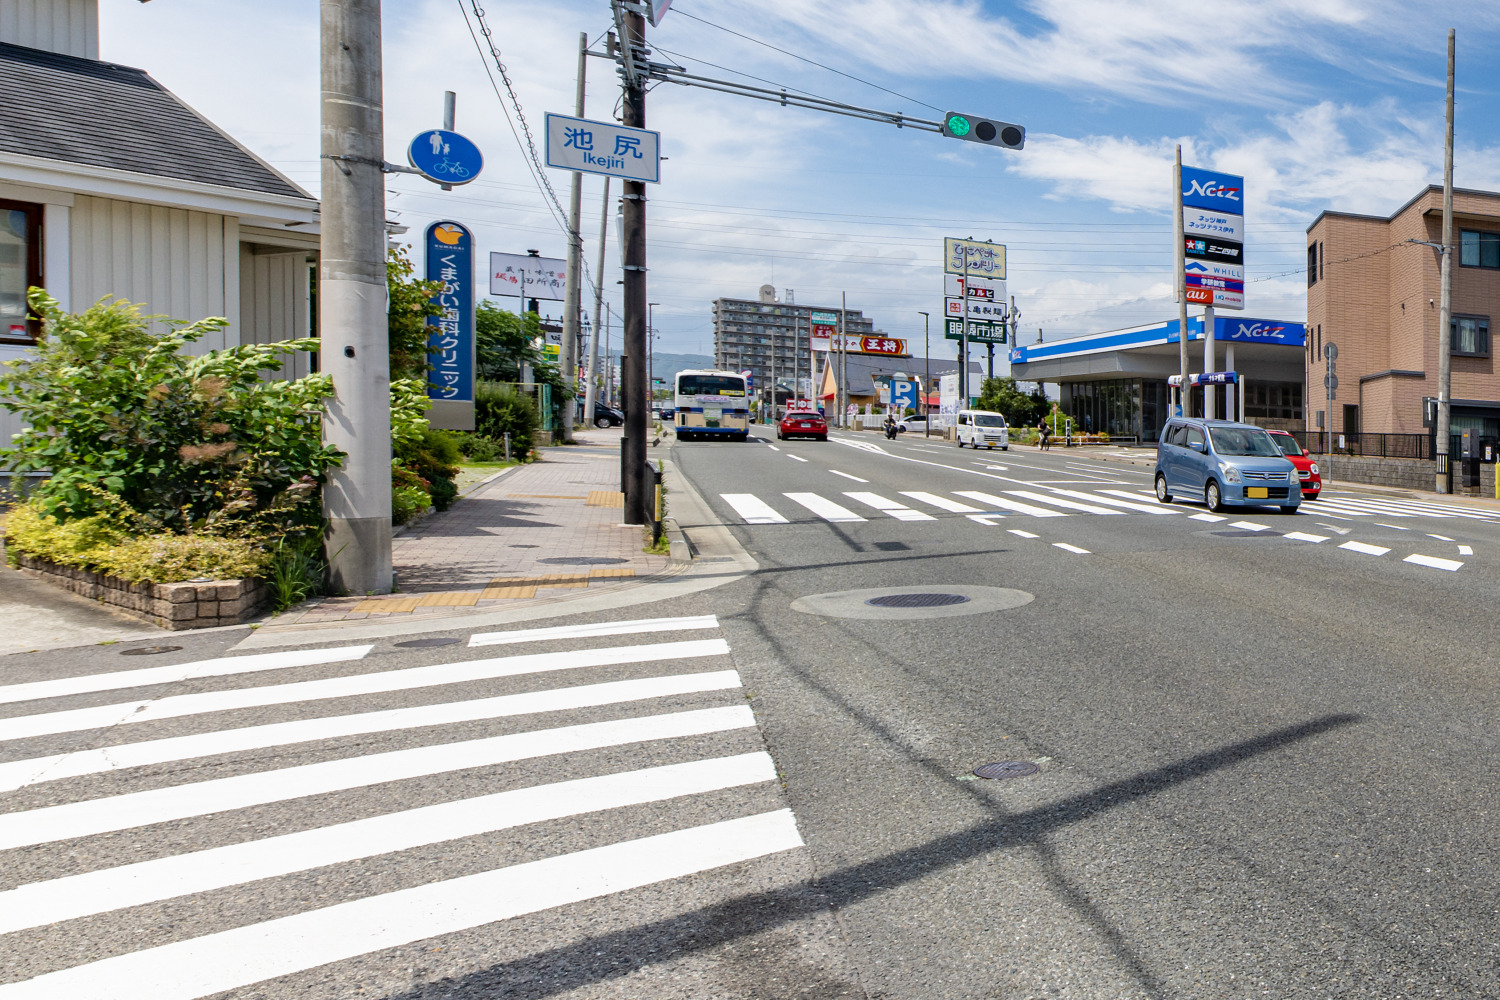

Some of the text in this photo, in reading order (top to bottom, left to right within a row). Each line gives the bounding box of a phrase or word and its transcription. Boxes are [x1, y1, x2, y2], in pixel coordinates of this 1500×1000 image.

[564, 126, 643, 159] 池尻
[583, 151, 625, 170] Ikejiri
[1182, 179, 1240, 201] Netz
[1198, 215, 1227, 224] ネッツ神戸
[1213, 267, 1241, 278] WHILL
[968, 288, 994, 298] カルビ
[1186, 290, 1208, 300] au
[439, 254, 461, 398] くまがい歯科クリニック
[1231, 323, 1285, 338] Netz
[895, 381, 911, 397] P
